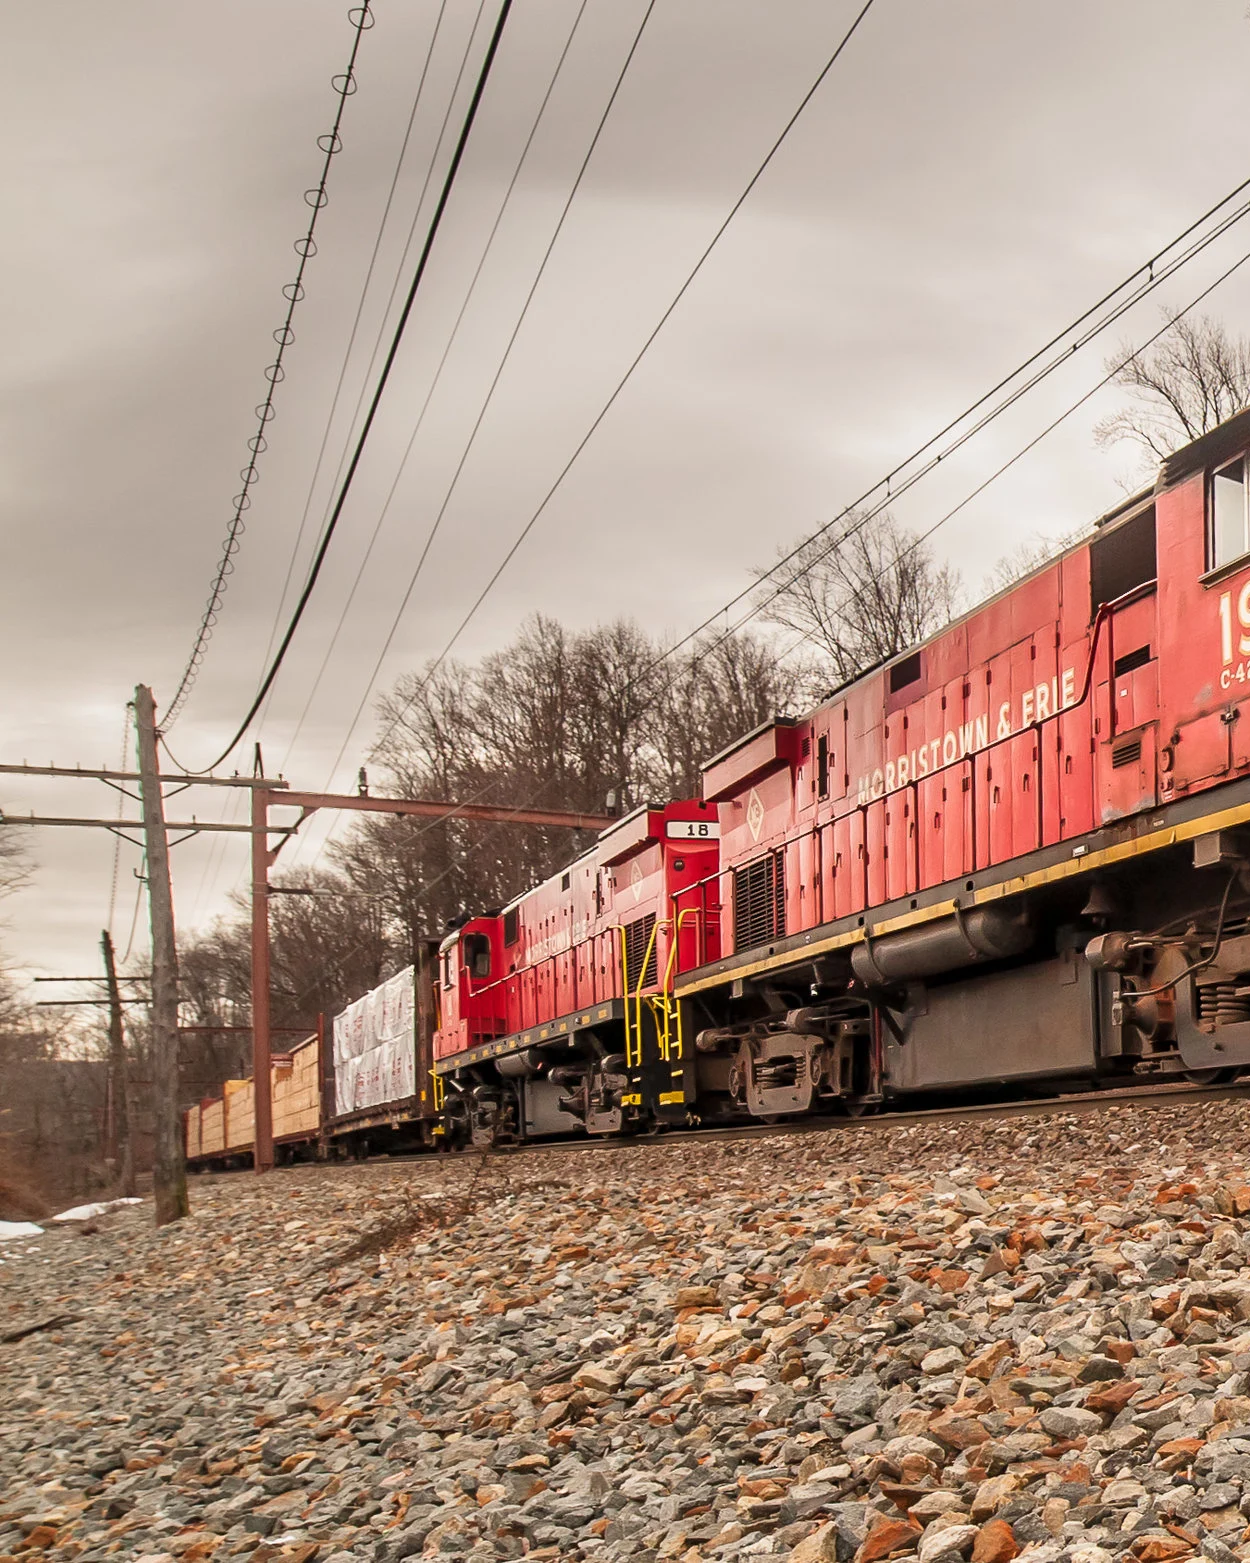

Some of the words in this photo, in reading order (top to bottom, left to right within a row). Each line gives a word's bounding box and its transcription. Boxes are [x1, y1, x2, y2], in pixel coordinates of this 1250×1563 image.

[857, 713, 988, 804] MORRISTOWN
[997, 701, 1012, 739] &
[1022, 667, 1075, 726] ERIE
[687, 824, 709, 836] 18
